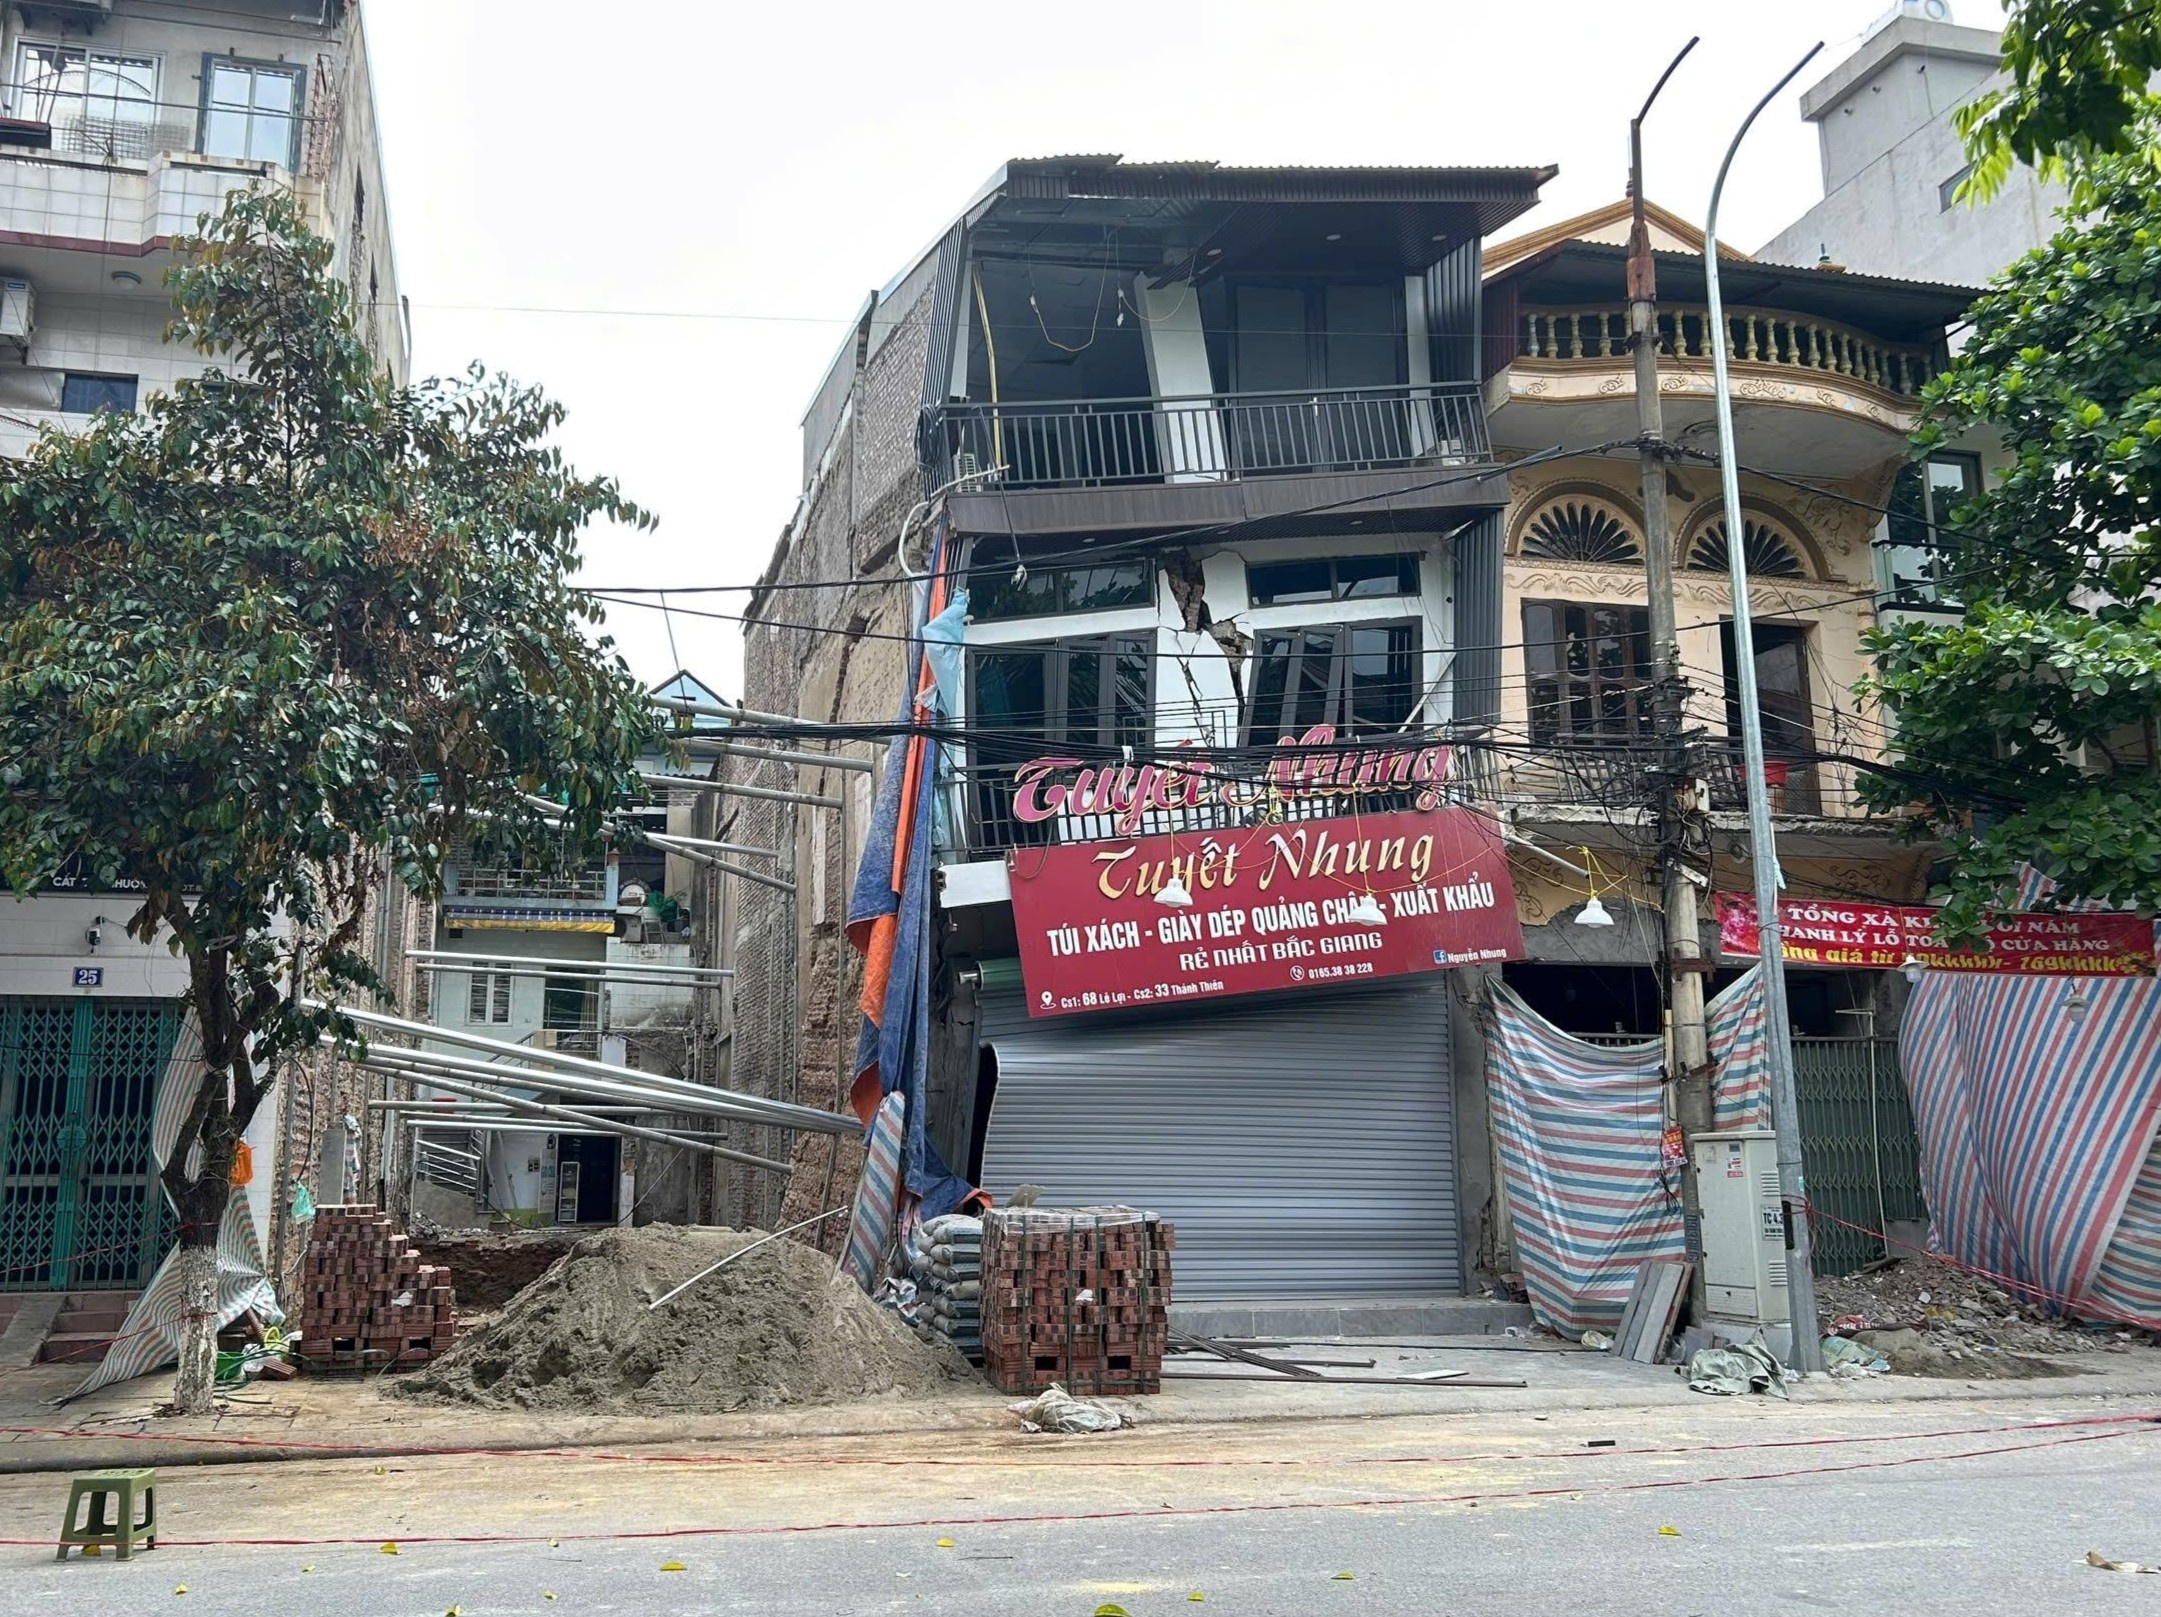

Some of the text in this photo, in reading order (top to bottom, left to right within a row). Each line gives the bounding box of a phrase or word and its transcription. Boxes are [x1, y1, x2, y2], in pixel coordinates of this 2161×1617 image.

[1219, 723, 1454, 812] Nhung
[1257, 828, 1435, 892] Nhung
[1046, 922, 1081, 957] TÚI
[1084, 918, 1141, 953] XÁCH
[1157, 909, 1203, 945] GIÀY
[1208, 904, 1247, 939] DÉP
[1251, 896, 1320, 936] QUẢNG
[1322, 890, 1366, 926] CHÂ
[1390, 881, 1441, 919] XUẤT
[1442, 870, 1496, 913] KHẨU
[1787, 903, 1857, 924] TỔNG
[1861, 910, 1900, 927] XẢ
[1778, 924, 1837, 943] HANH
[1840, 927, 1868, 944] LÝ
[1872, 927, 1900, 946] LỖ
[2000, 935, 2049, 951] CỬA
[2052, 937, 2111, 951] HÀNG
[1179, 931, 1383, 971] RẺ NHẤT BẮC GIANG
[1447, 947, 1479, 964] Nguyễn
[1480, 947, 1508, 961] Nhung
[1760, 940, 1818, 961] ồng
[1825, 946, 1864, 964] giá
[77, 969, 99, 985] 25
[1308, 962, 1374, 980] 0165.38 38 228
[1060, 997, 1081, 1009] Cs1:
[1081, 991, 1097, 1007] 68
[1133, 989, 1154, 1001] Cs2:
[1154, 983, 1170, 998] 33
[1763, 1212, 1772, 1225] TC
